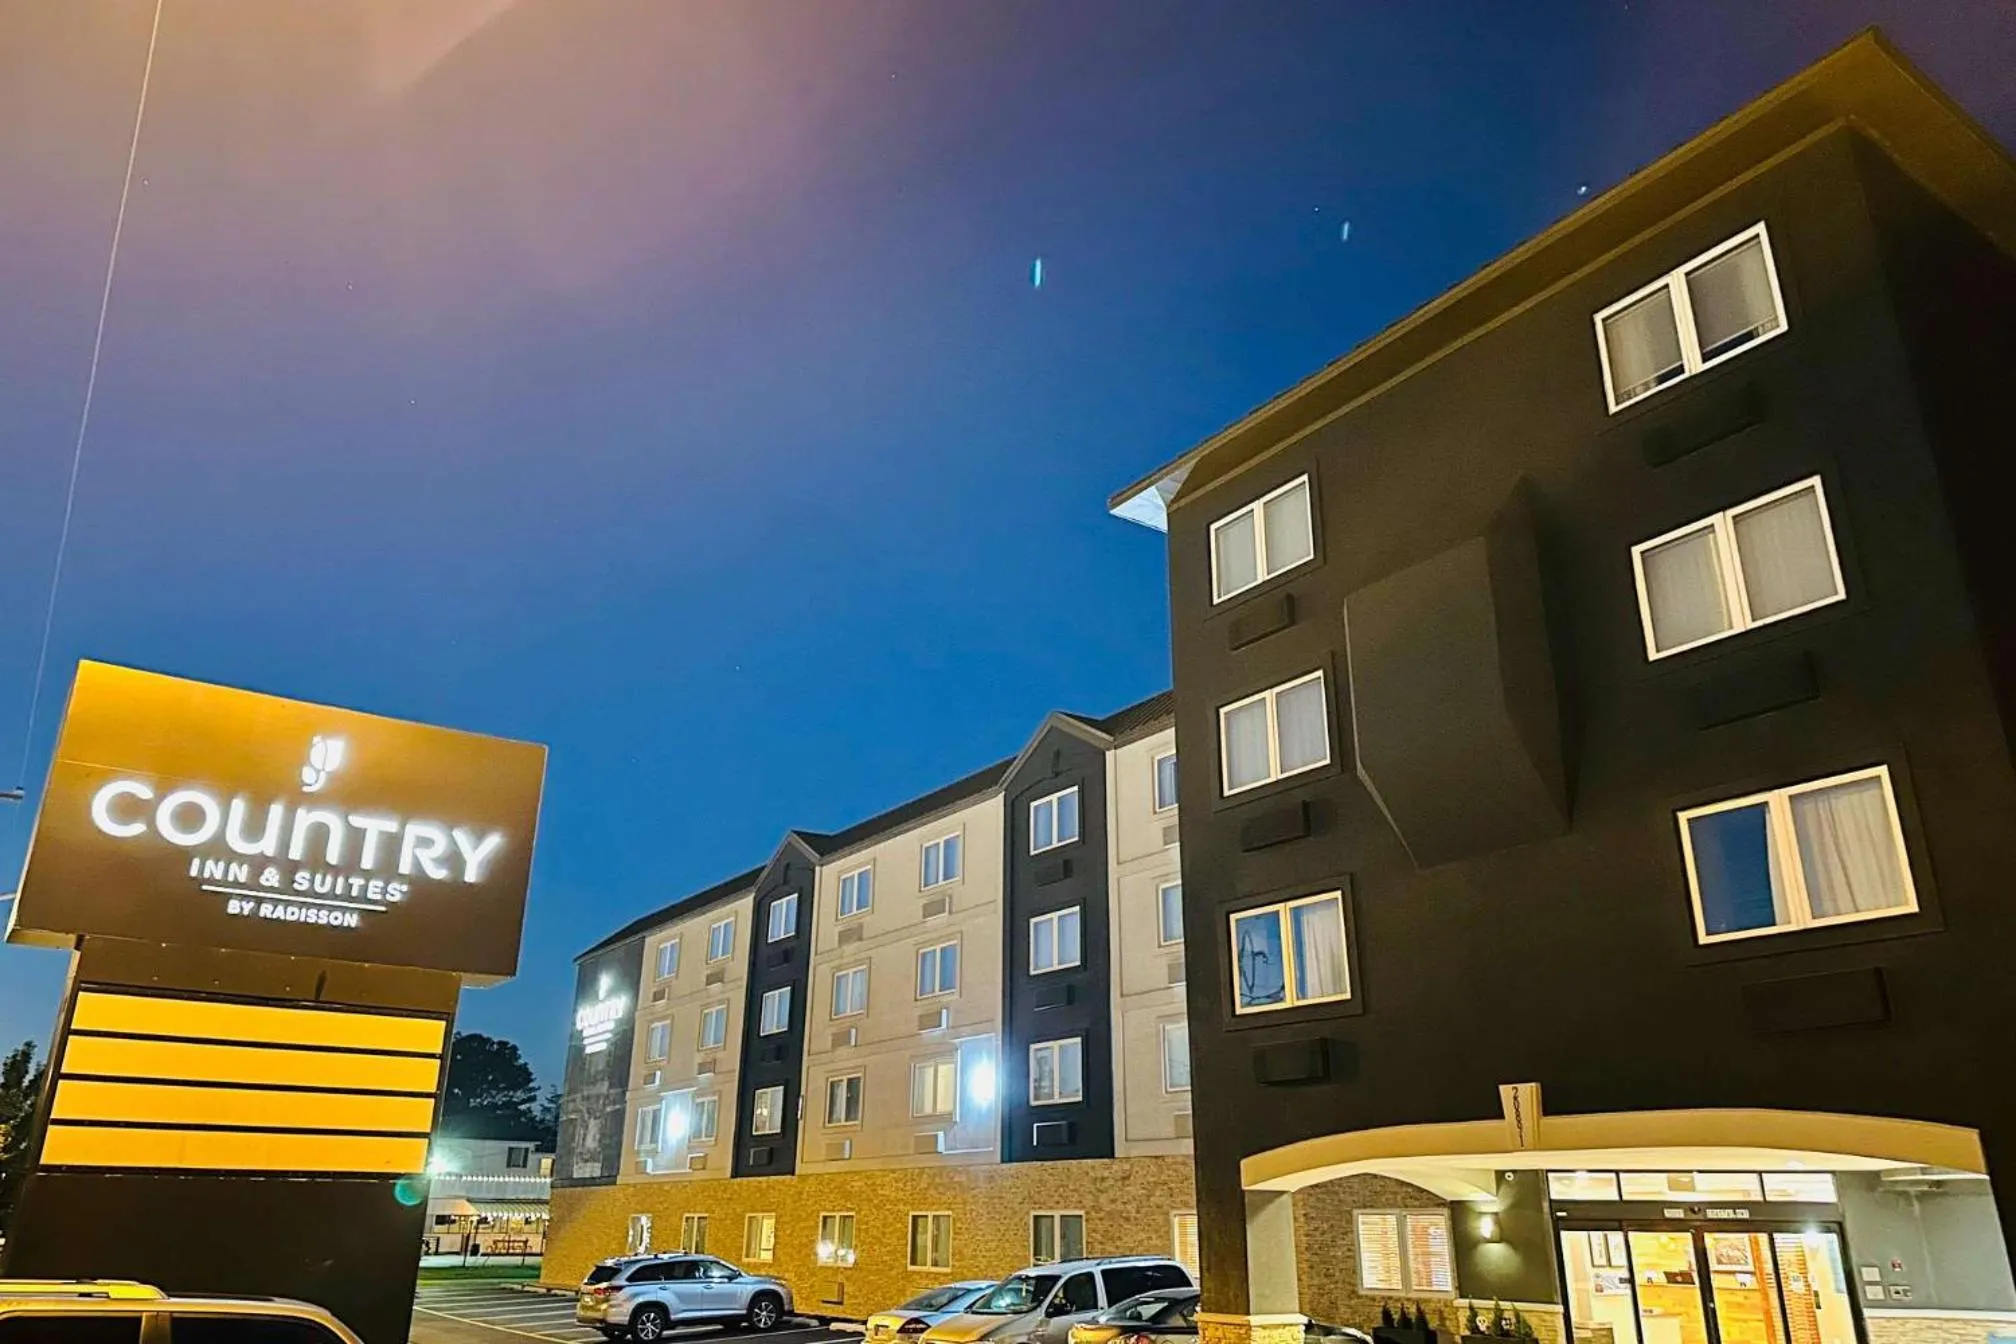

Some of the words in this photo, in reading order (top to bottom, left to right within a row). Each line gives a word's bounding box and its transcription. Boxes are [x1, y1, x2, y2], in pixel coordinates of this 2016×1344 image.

[91, 780, 502, 884] COUNTRY
[189, 857, 248, 883] INN
[259, 866, 280, 888] &
[293, 871, 403, 902] SUITES
[226, 899, 255, 916] BY
[258, 902, 359, 928] RADISSON
